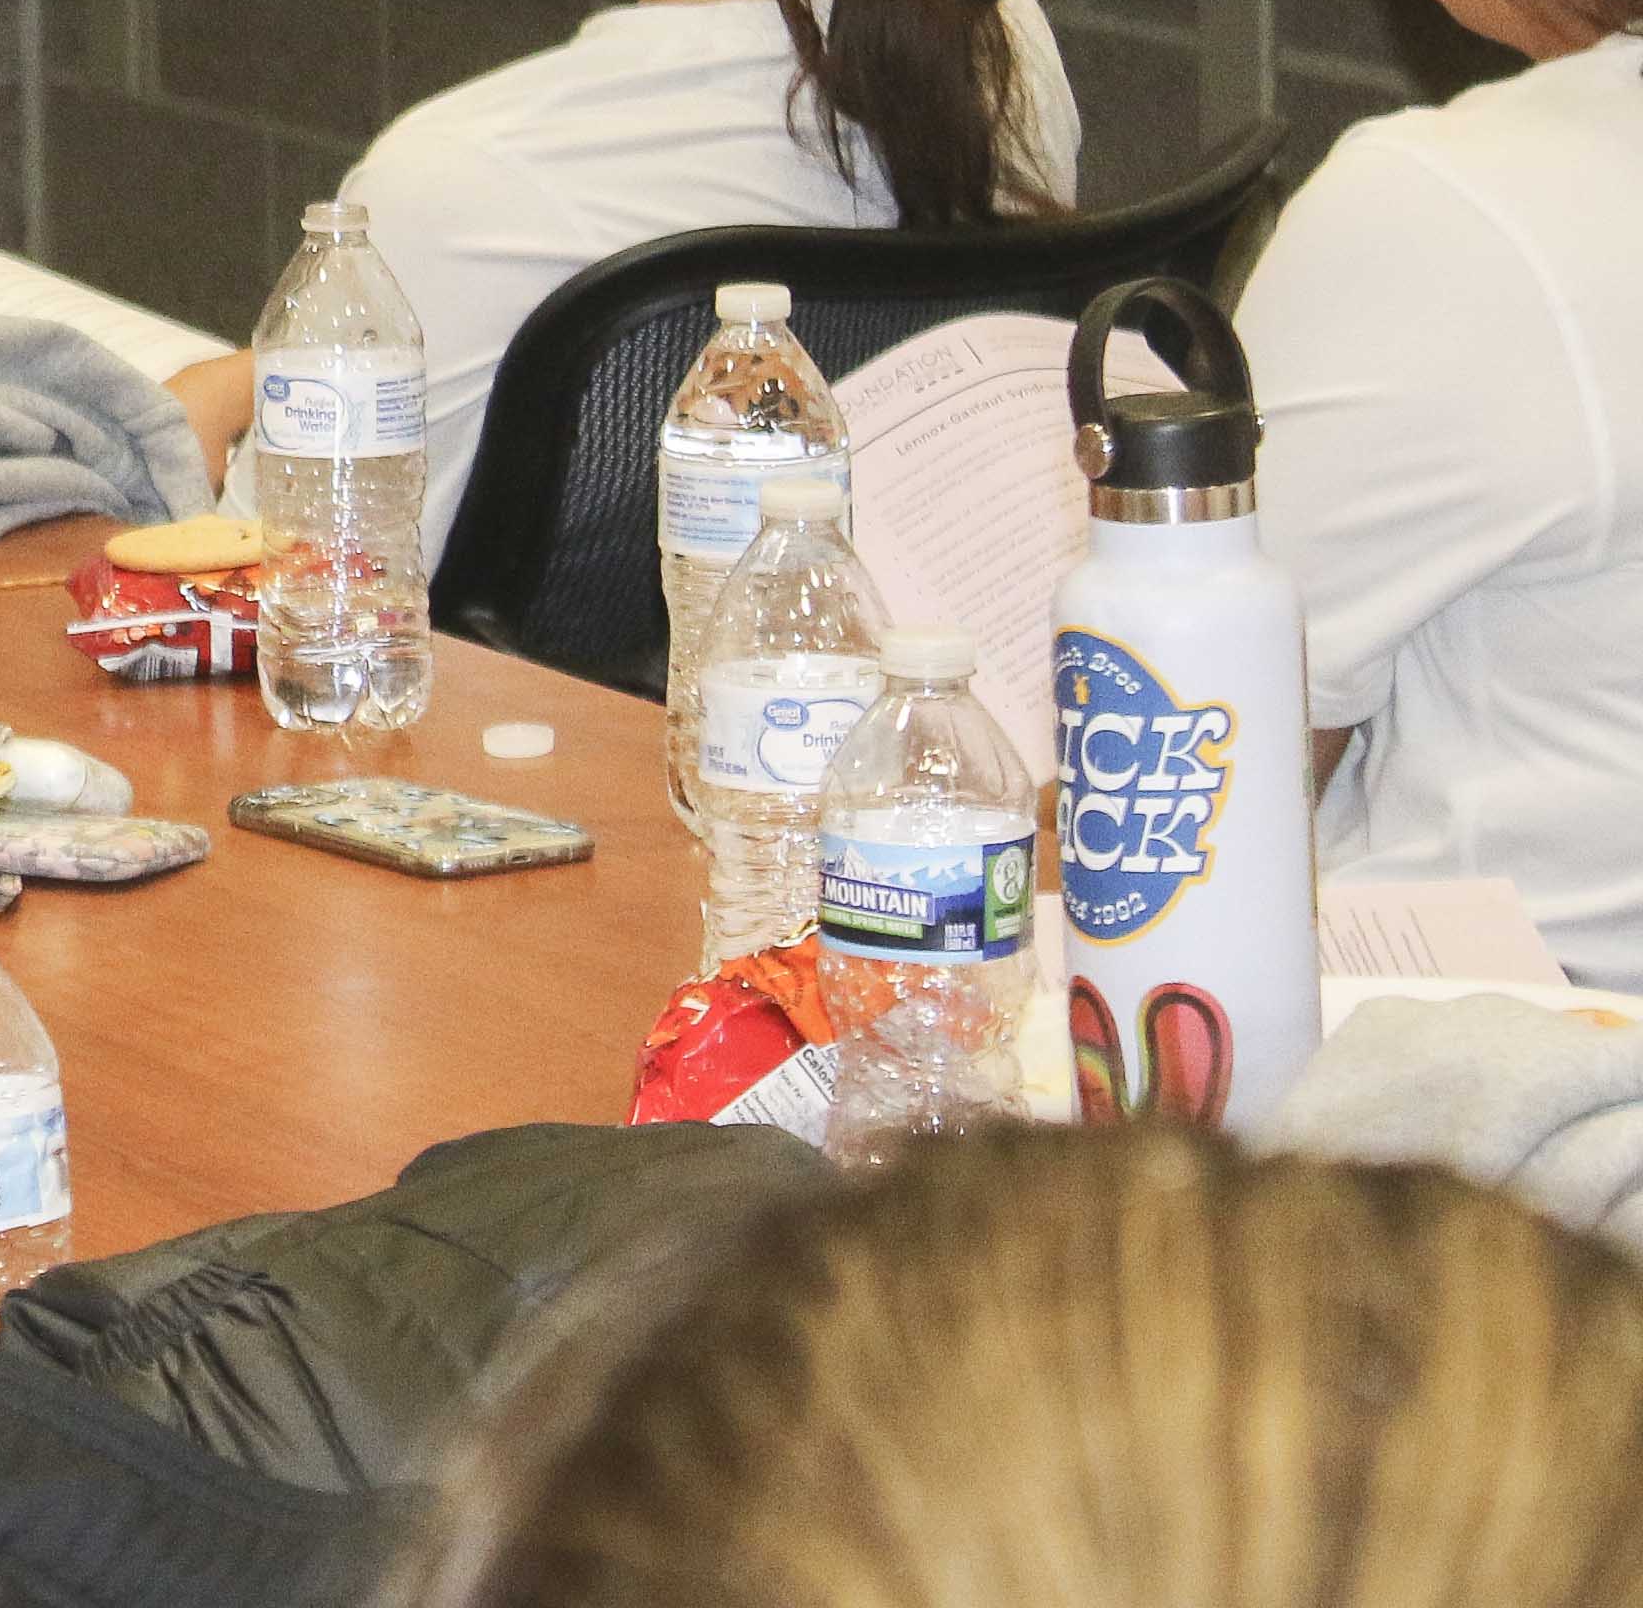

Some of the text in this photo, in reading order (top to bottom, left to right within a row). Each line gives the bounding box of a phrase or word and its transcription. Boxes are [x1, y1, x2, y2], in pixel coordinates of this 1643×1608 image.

[839, 344, 955, 418] OUNDATION
[284, 406, 337, 423] Drinking
[802, 733, 846, 749] Drink
[824, 876, 928, 919] MOUNTAIN
[1091, 891, 1148, 926] 1992
[801, 1048, 836, 1098] Calori
